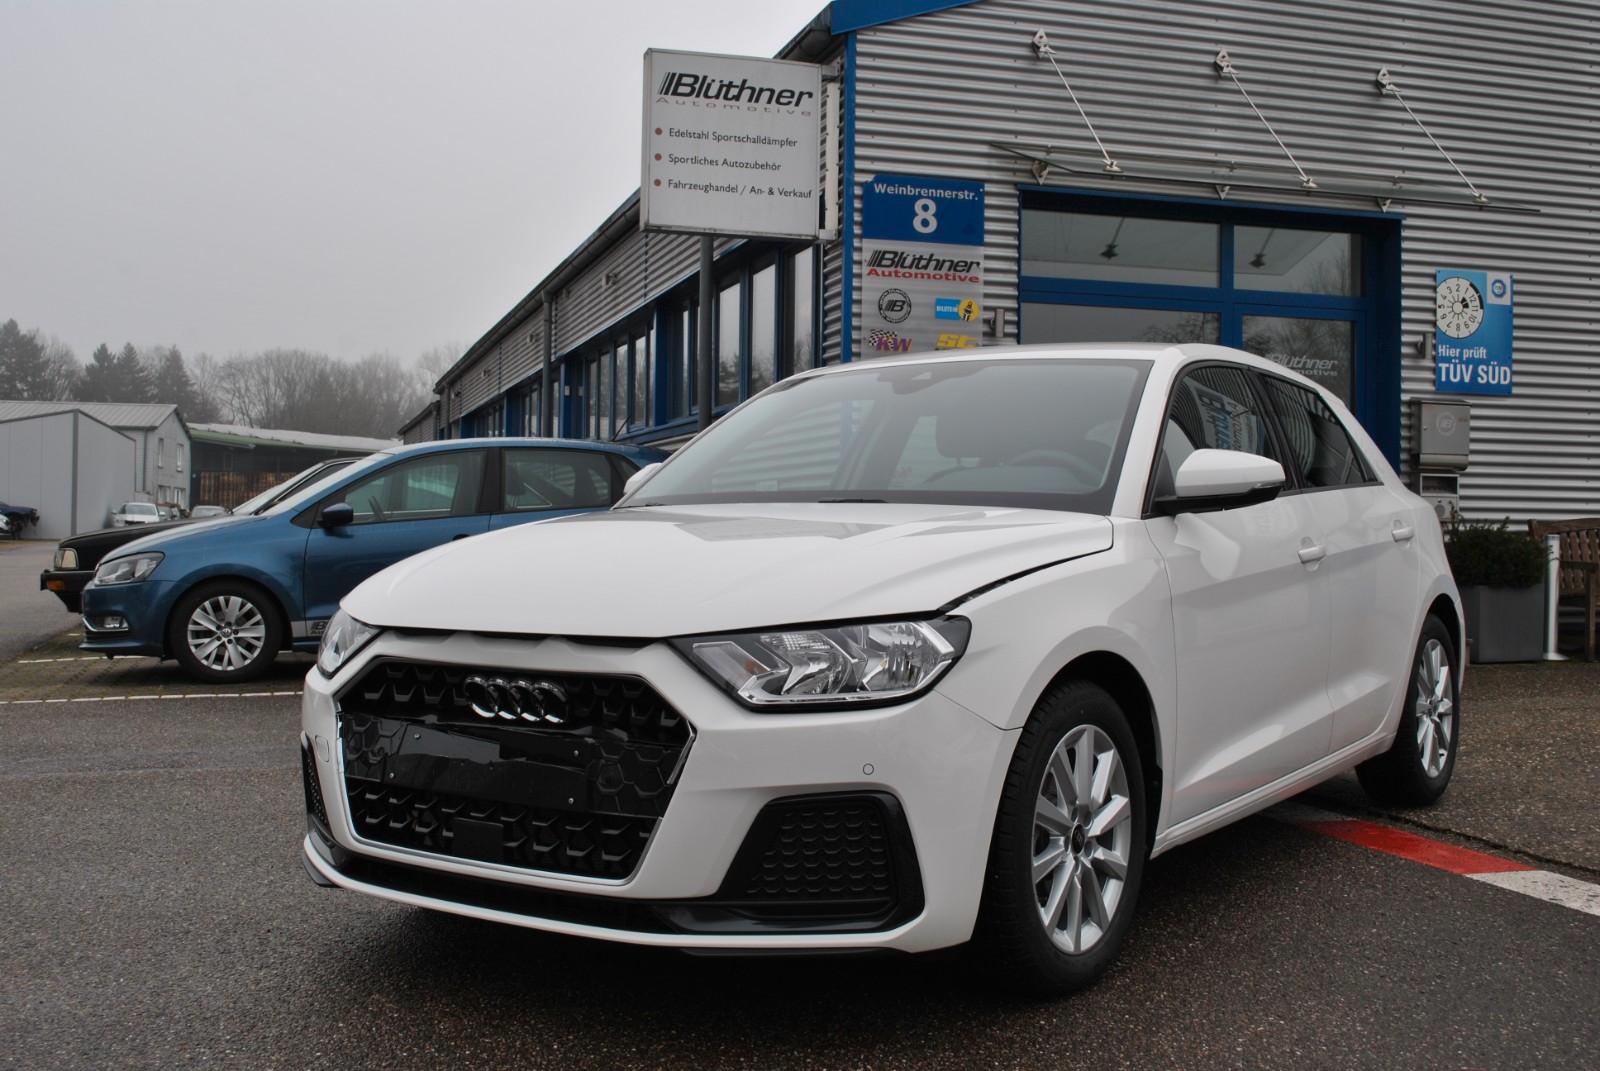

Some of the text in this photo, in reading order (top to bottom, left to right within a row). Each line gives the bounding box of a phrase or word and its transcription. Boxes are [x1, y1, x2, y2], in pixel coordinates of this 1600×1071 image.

[660, 71, 813, 107] Blüthner
[655, 96, 811, 117] Automotive
[669, 127, 798, 148] Edelstahl Sportschalldämpfer
[668, 153, 782, 171] Sportliches Autozubehör
[667, 179, 738, 194] Fahrzeughandel
[768, 187, 774, 196] &
[777, 187, 812, 199] Verkauf
[874, 183, 979, 201] Weinbrennerstr.
[912, 198, 938, 234] 8
[868, 249, 981, 273] Blüthner
[866, 268, 980, 283] Automotive
[1438, 344, 1487, 361] Hier prüft
[1438, 359, 1511, 385] TÜV SÜD
